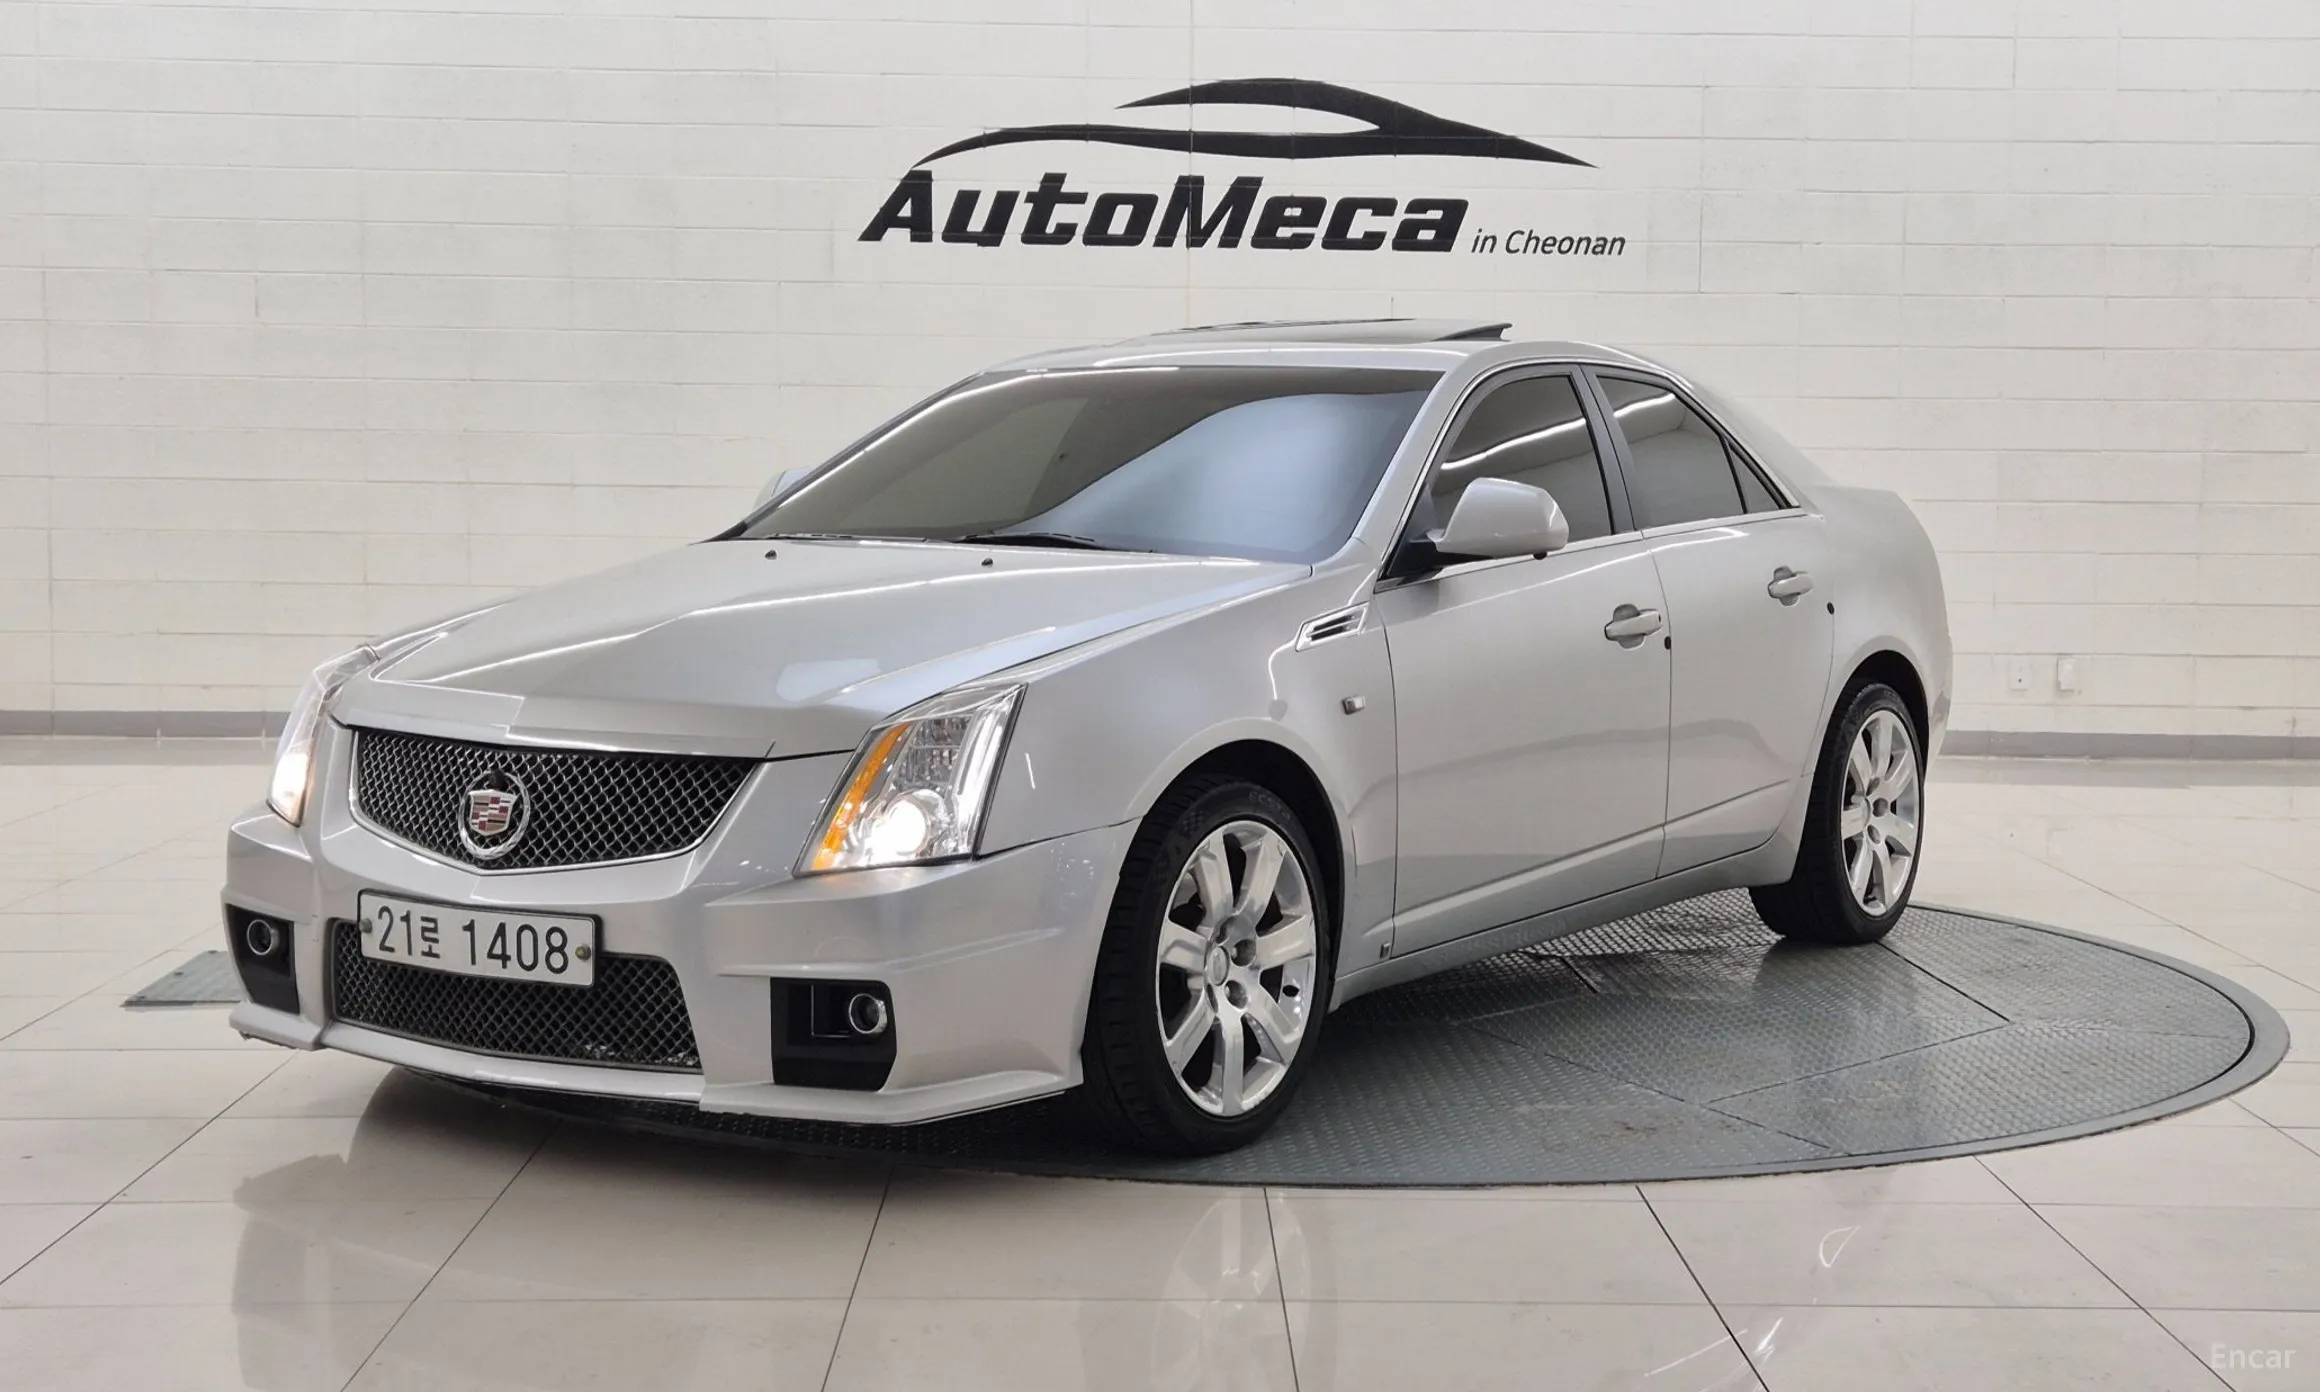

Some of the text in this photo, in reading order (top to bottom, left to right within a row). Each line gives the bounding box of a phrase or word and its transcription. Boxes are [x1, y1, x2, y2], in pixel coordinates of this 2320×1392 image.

[858, 169, 1626, 256] AutoMeca in Cheonan
[377, 905, 569, 975] 21로 1408
